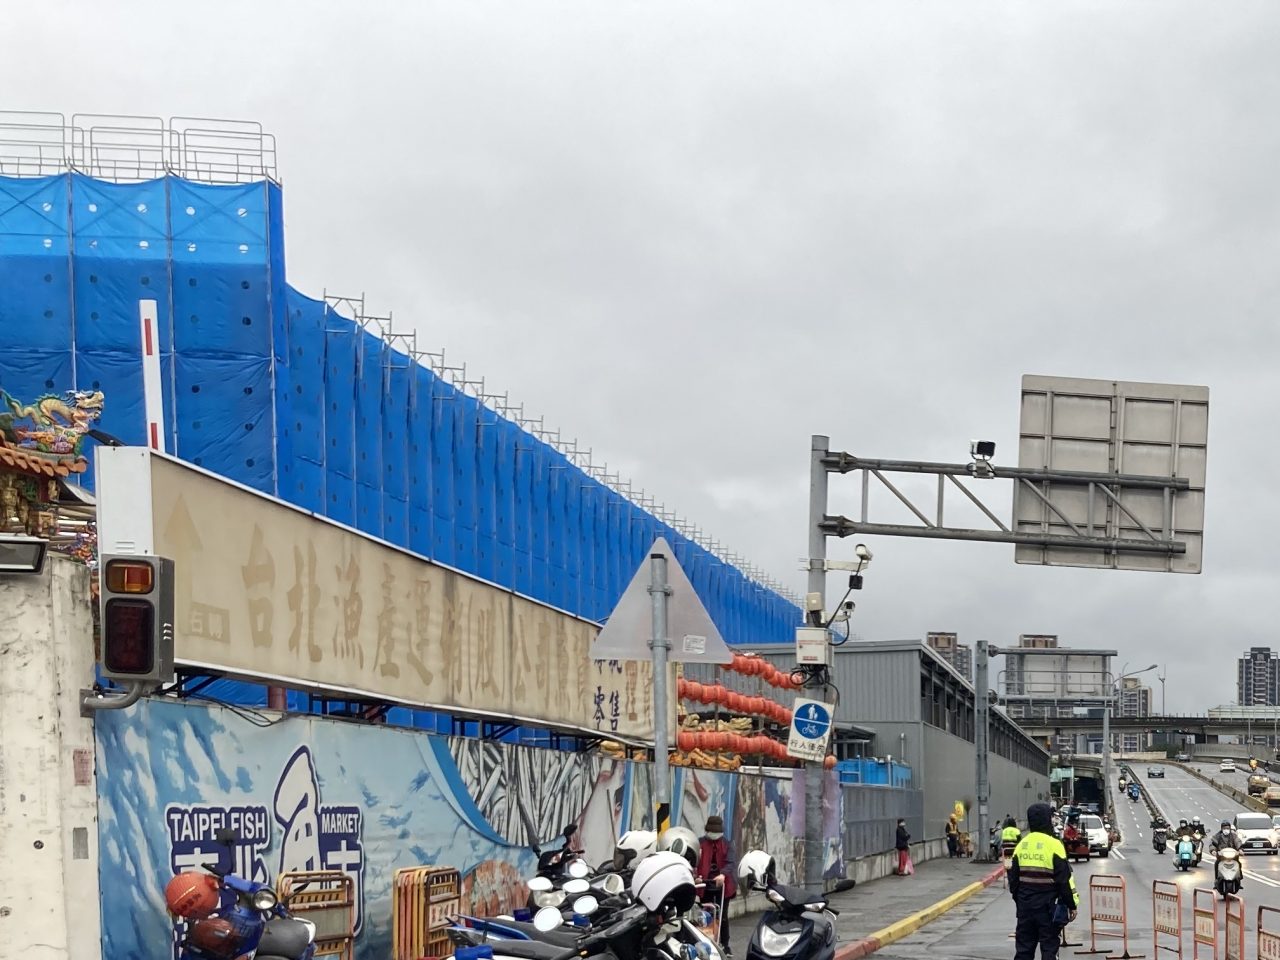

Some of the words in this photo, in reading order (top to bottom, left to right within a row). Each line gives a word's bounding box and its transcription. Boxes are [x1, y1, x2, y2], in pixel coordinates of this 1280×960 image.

[231, 812, 266, 839] FISH
[321, 813, 359, 834] MARKET
[1019, 852, 1045, 861] POLICE
